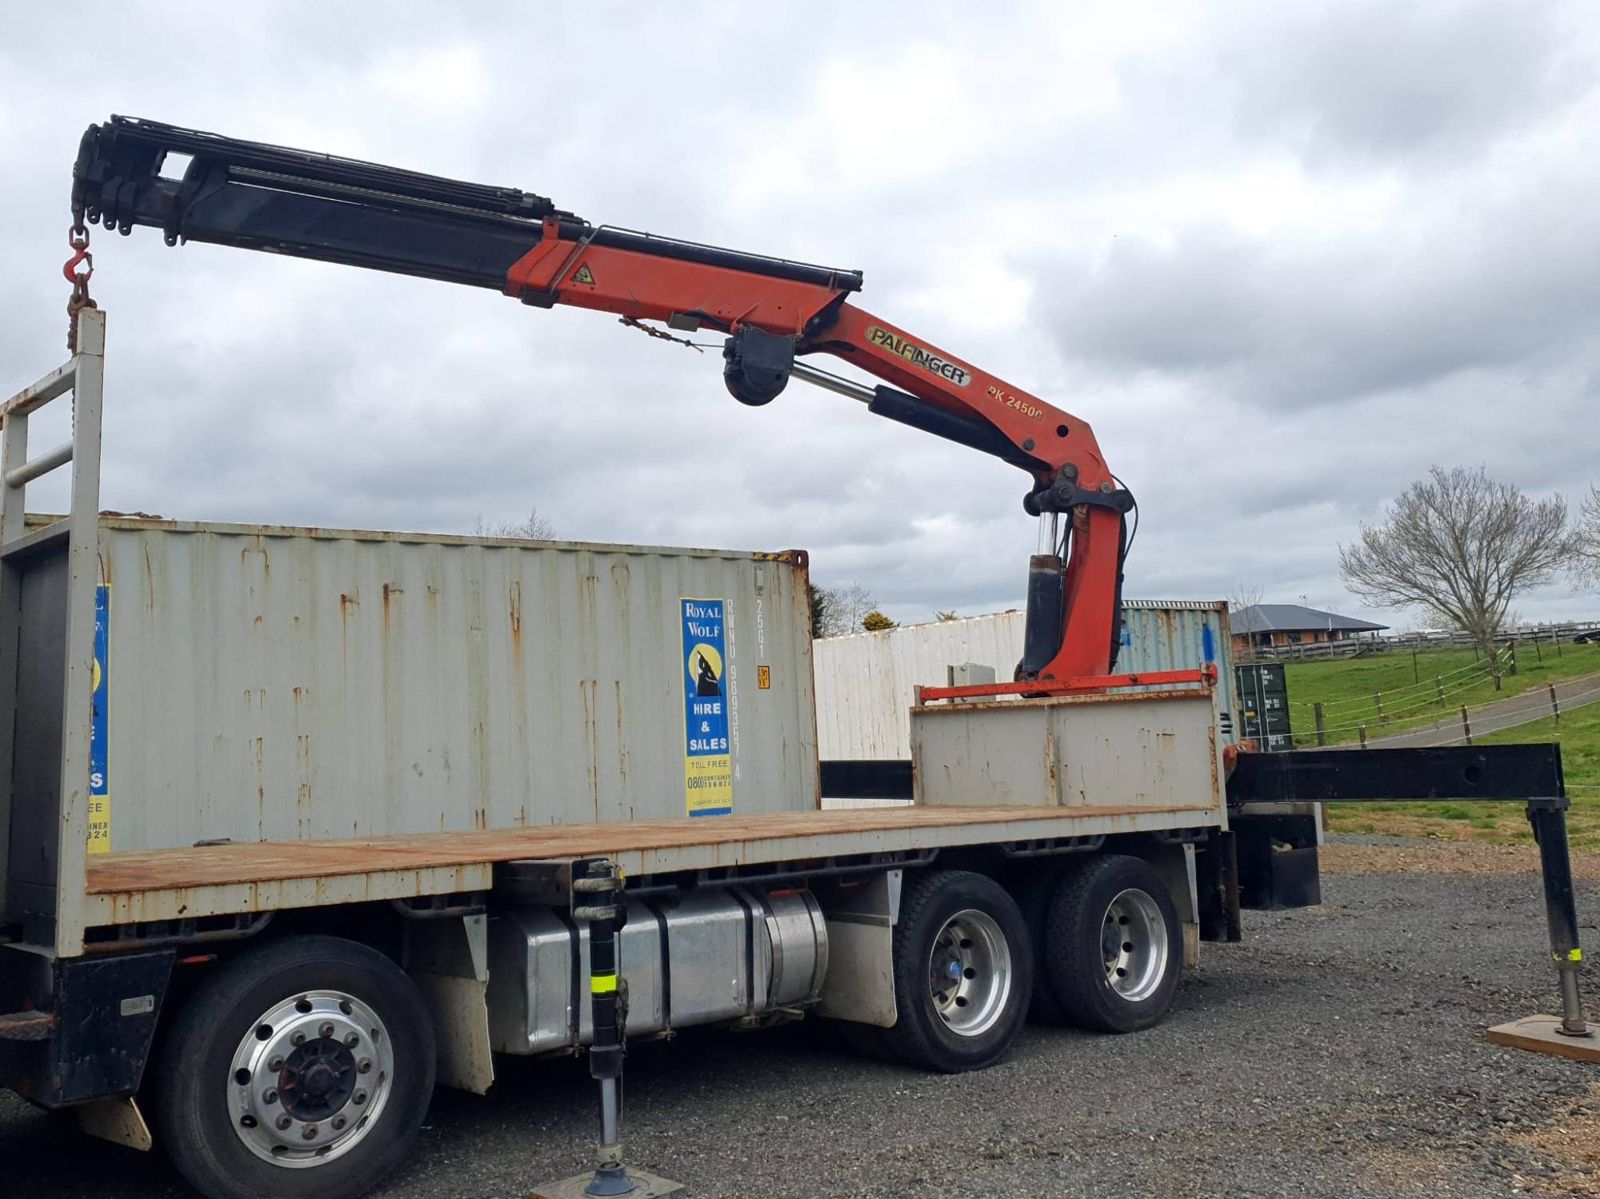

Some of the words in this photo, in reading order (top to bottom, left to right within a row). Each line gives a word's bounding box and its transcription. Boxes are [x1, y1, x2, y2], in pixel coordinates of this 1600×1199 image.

[871, 328, 965, 384] PALFINGER
[988, 386, 1005, 402] PK
[685, 602, 722, 618] ROYAL
[687, 622, 721, 637] WOLF
[693, 703, 722, 715] HIRE
[701, 721, 710, 733] &
[689, 738, 727, 751] SALES
[691, 761, 706, 769] TOLL
[707, 760, 729, 769] FREE
